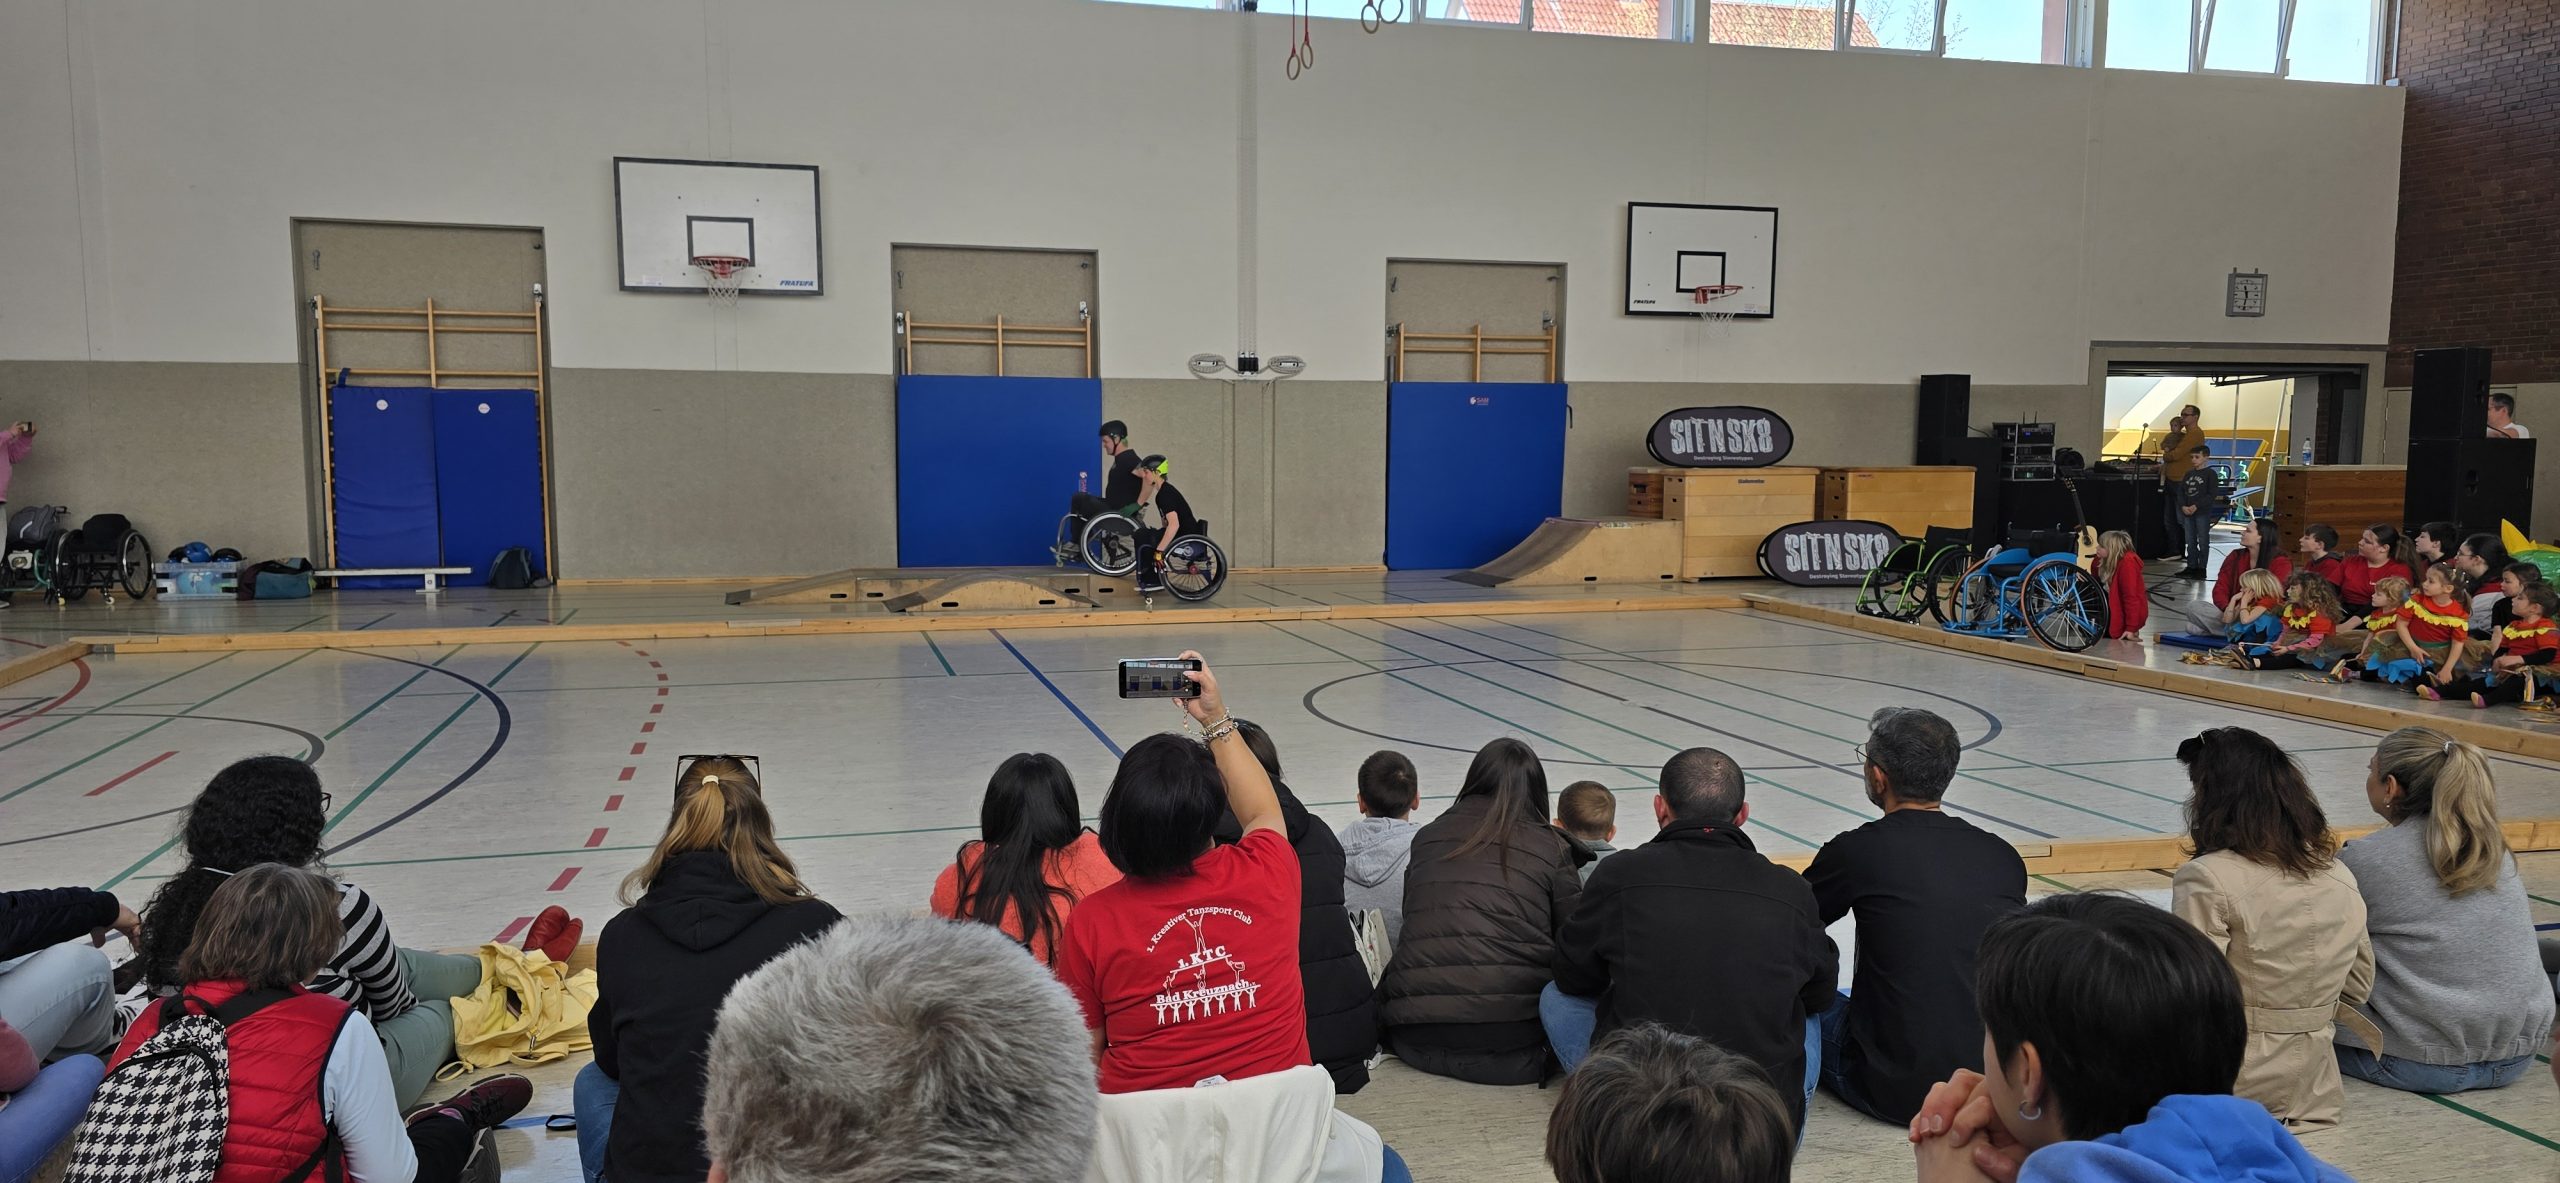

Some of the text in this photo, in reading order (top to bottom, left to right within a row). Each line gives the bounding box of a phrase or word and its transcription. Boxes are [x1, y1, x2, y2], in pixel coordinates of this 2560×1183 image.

[1151, 913, 1187, 944] Kreativer
[1187, 906, 1233, 917] Tanzsport
[1234, 910, 1253, 925] Club
[1156, 991, 1180, 1004] Bad
[1182, 979, 1249, 1000] Kreuznach
